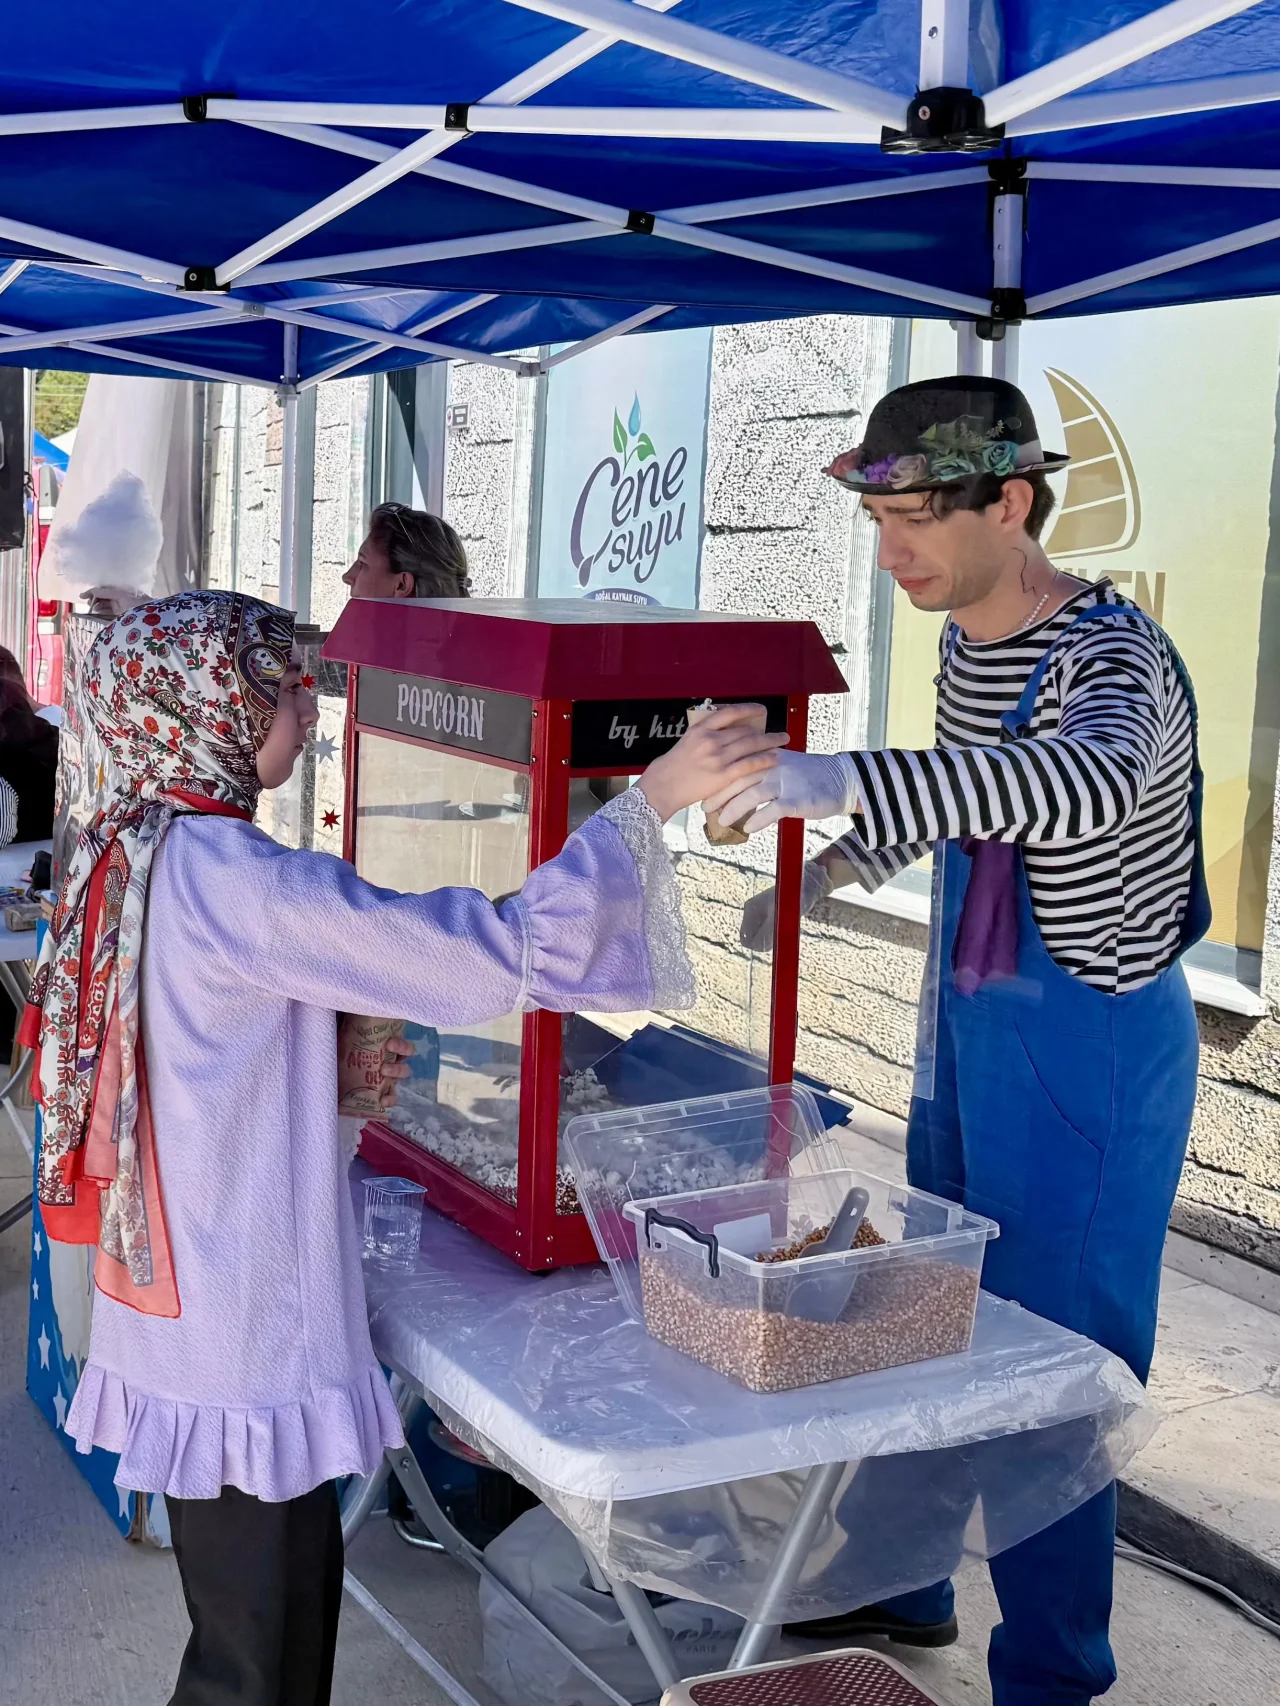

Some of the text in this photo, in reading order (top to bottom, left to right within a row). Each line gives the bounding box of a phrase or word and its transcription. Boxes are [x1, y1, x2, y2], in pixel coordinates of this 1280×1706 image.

[608, 502, 686, 584] suyu
[611, 592, 633, 602] KAYNAK
[396, 683, 486, 741] POPCORN
[608, 715, 639, 748] by
